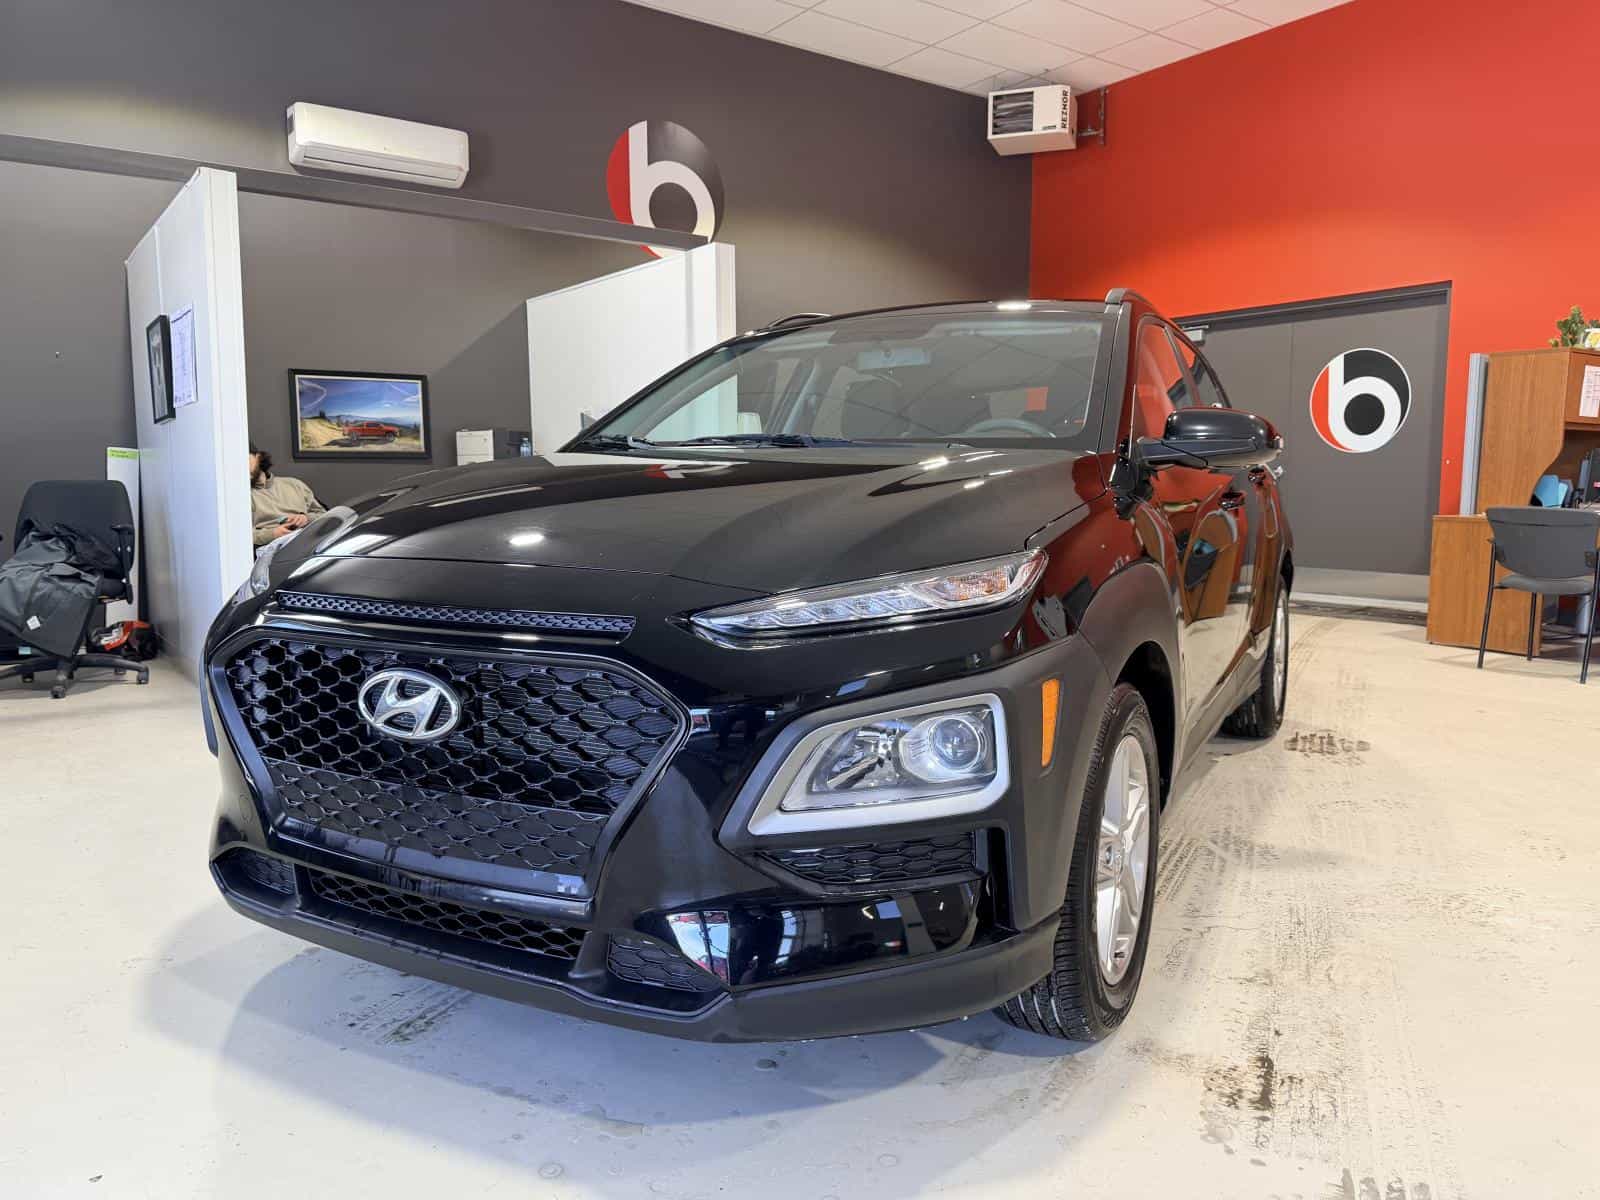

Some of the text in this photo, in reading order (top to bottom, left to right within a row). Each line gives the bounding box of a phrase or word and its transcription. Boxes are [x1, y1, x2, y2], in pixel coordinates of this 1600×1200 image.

[1061, 90, 1069, 129] REZNOR
[628, 120, 716, 258] b
[1328, 353, 1402, 453] b
